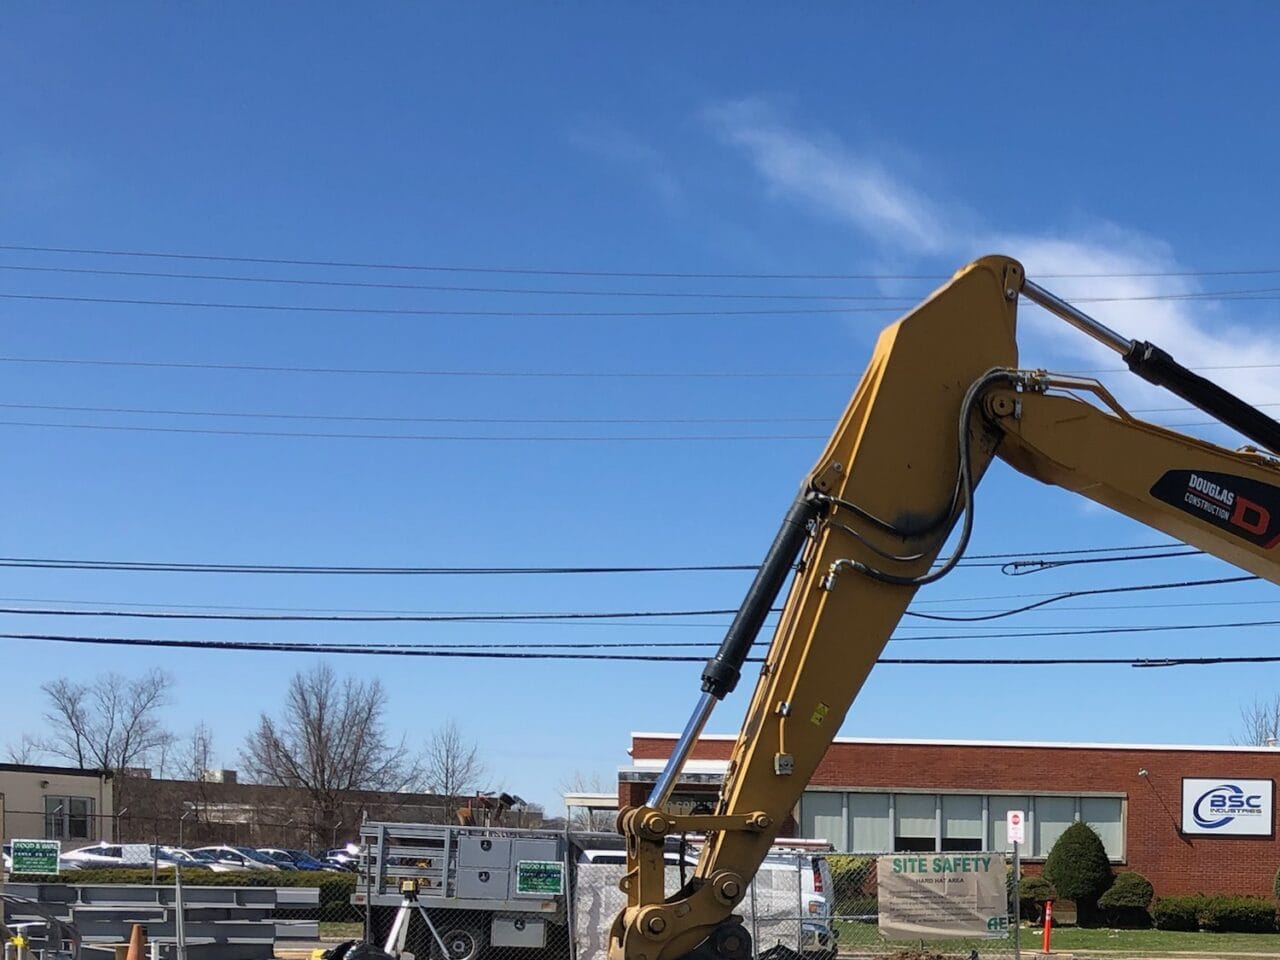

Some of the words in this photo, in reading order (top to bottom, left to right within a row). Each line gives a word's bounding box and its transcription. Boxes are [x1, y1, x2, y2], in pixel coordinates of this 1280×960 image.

[1188, 474, 1235, 506] DOUGLAS
[1184, 492, 1230, 521] CONSTRUCTION
[1230, 495, 1270, 536] D
[1210, 794, 1262, 808] BSC
[892, 857, 928, 873] SITE
[932, 857, 991, 873] SAFETY
